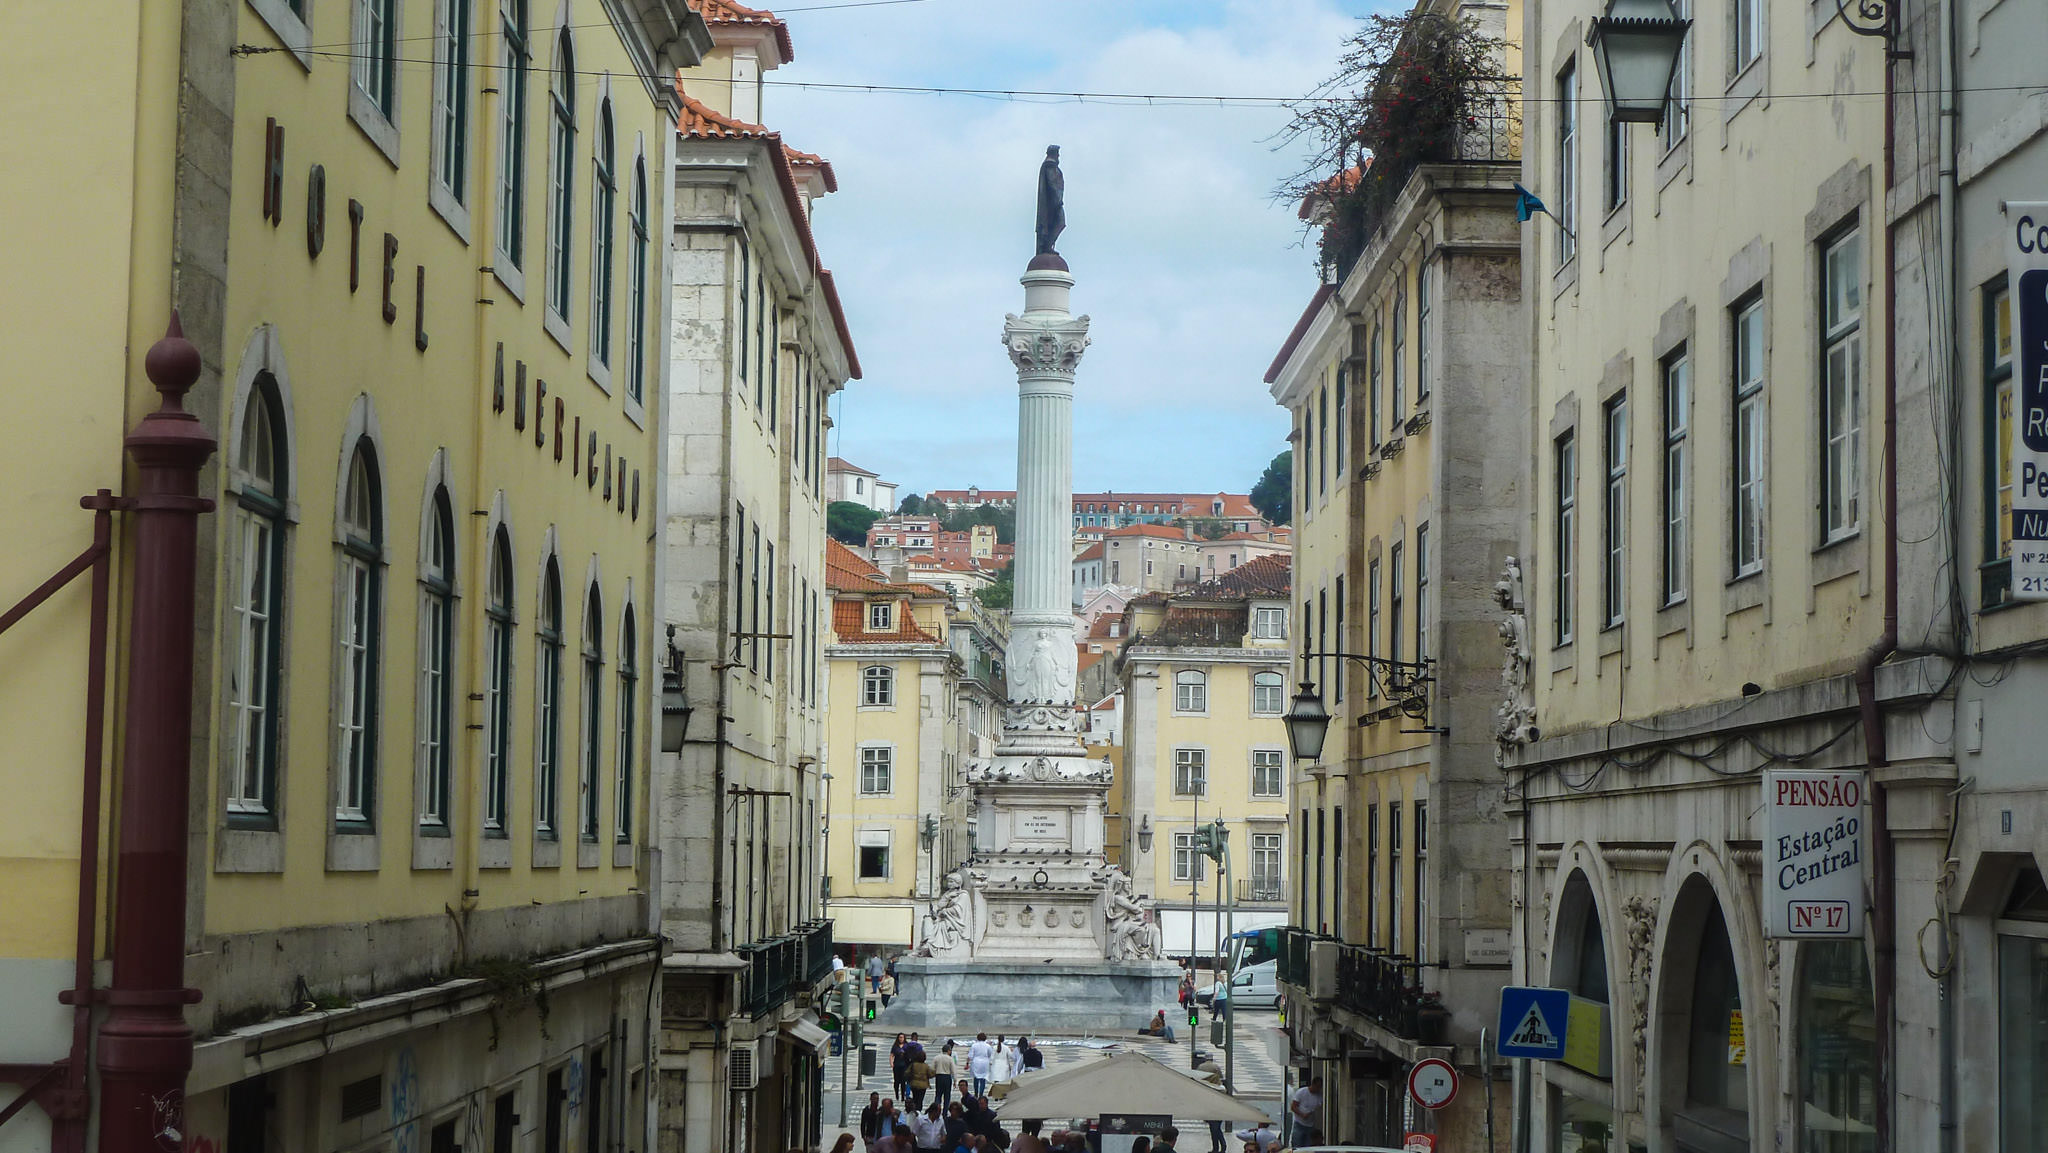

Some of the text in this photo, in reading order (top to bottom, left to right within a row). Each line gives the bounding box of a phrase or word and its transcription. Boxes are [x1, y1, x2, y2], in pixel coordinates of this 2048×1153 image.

[264, 117, 428, 353] HOTEL
[493, 341, 640, 522] AMERICANO
[2027, 407, 2048, 437] R
[2022, 462, 2048, 498] Pe
[2021, 552, 2048, 564] Nº 2
[1776, 775, 1859, 807] PENSÃO
[1777, 816, 1858, 862] Estação
[1778, 839, 1860, 891] Central
[1795, 906, 1843, 928] Nº 17
